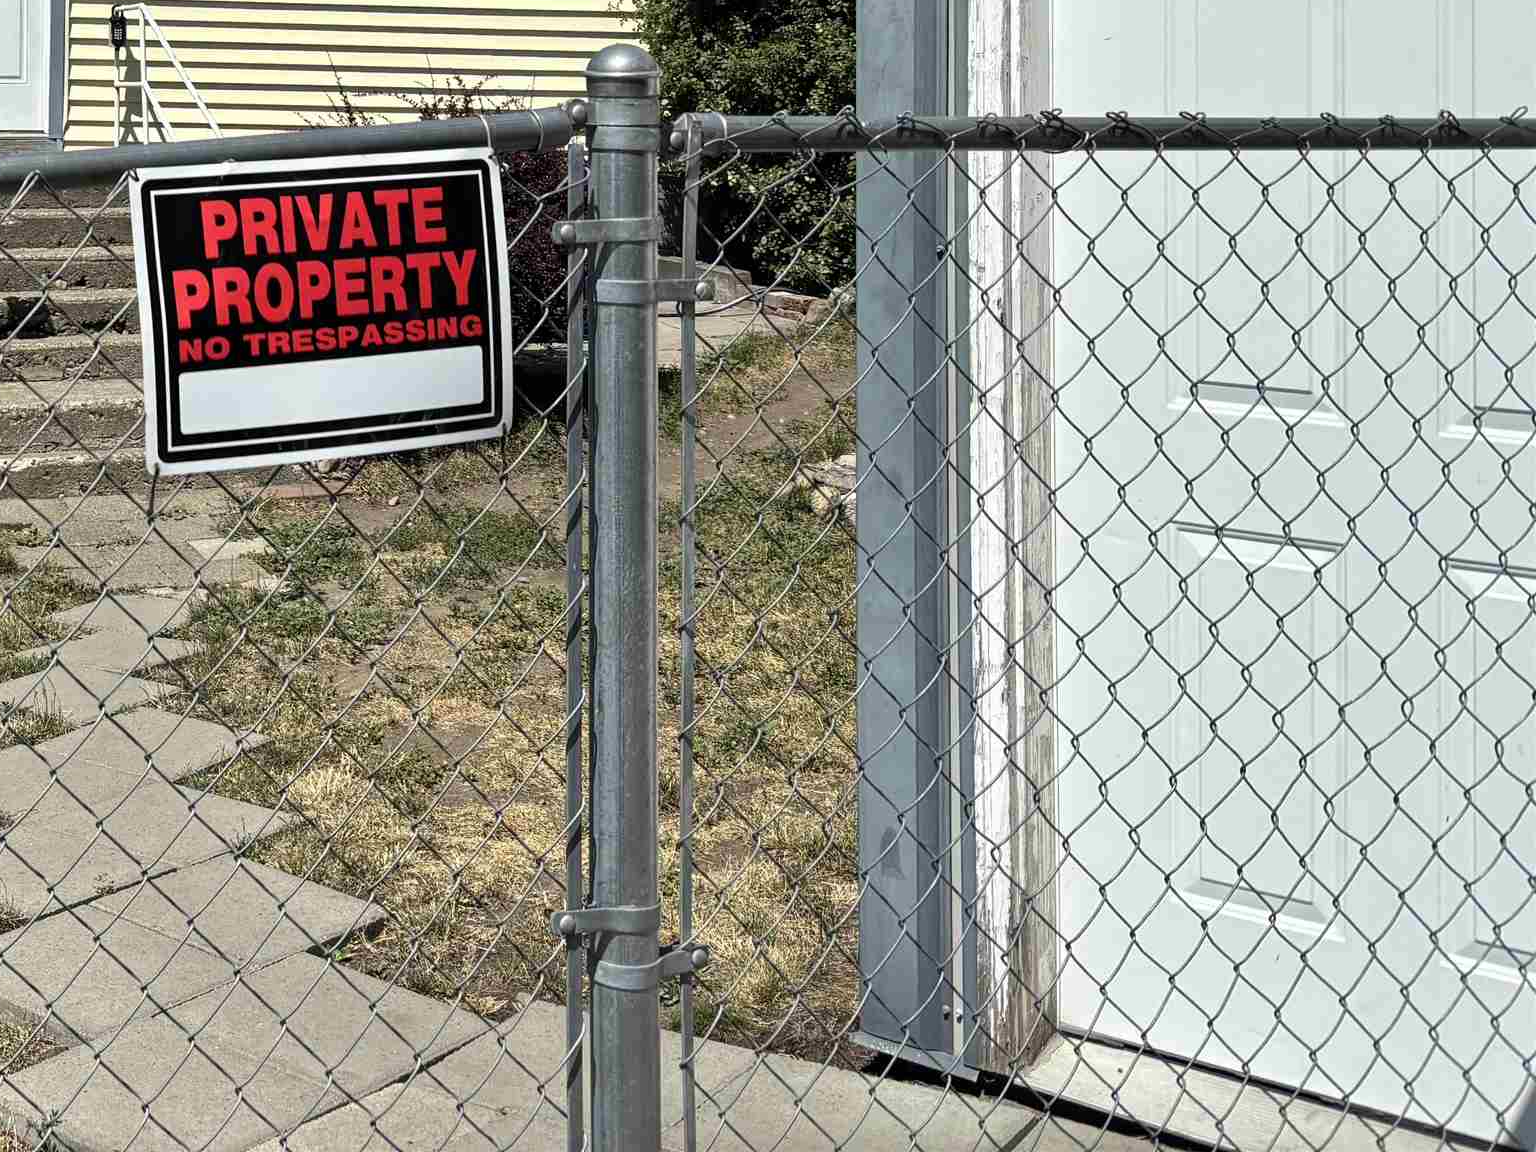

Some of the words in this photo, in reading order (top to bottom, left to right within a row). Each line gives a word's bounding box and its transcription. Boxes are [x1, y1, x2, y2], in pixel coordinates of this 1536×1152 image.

[200, 186, 447, 259] PRIVATE
[172, 249, 477, 330] PROPERTY
[179, 337, 231, 363] NO
[243, 314, 483, 357] TRESPASSING
